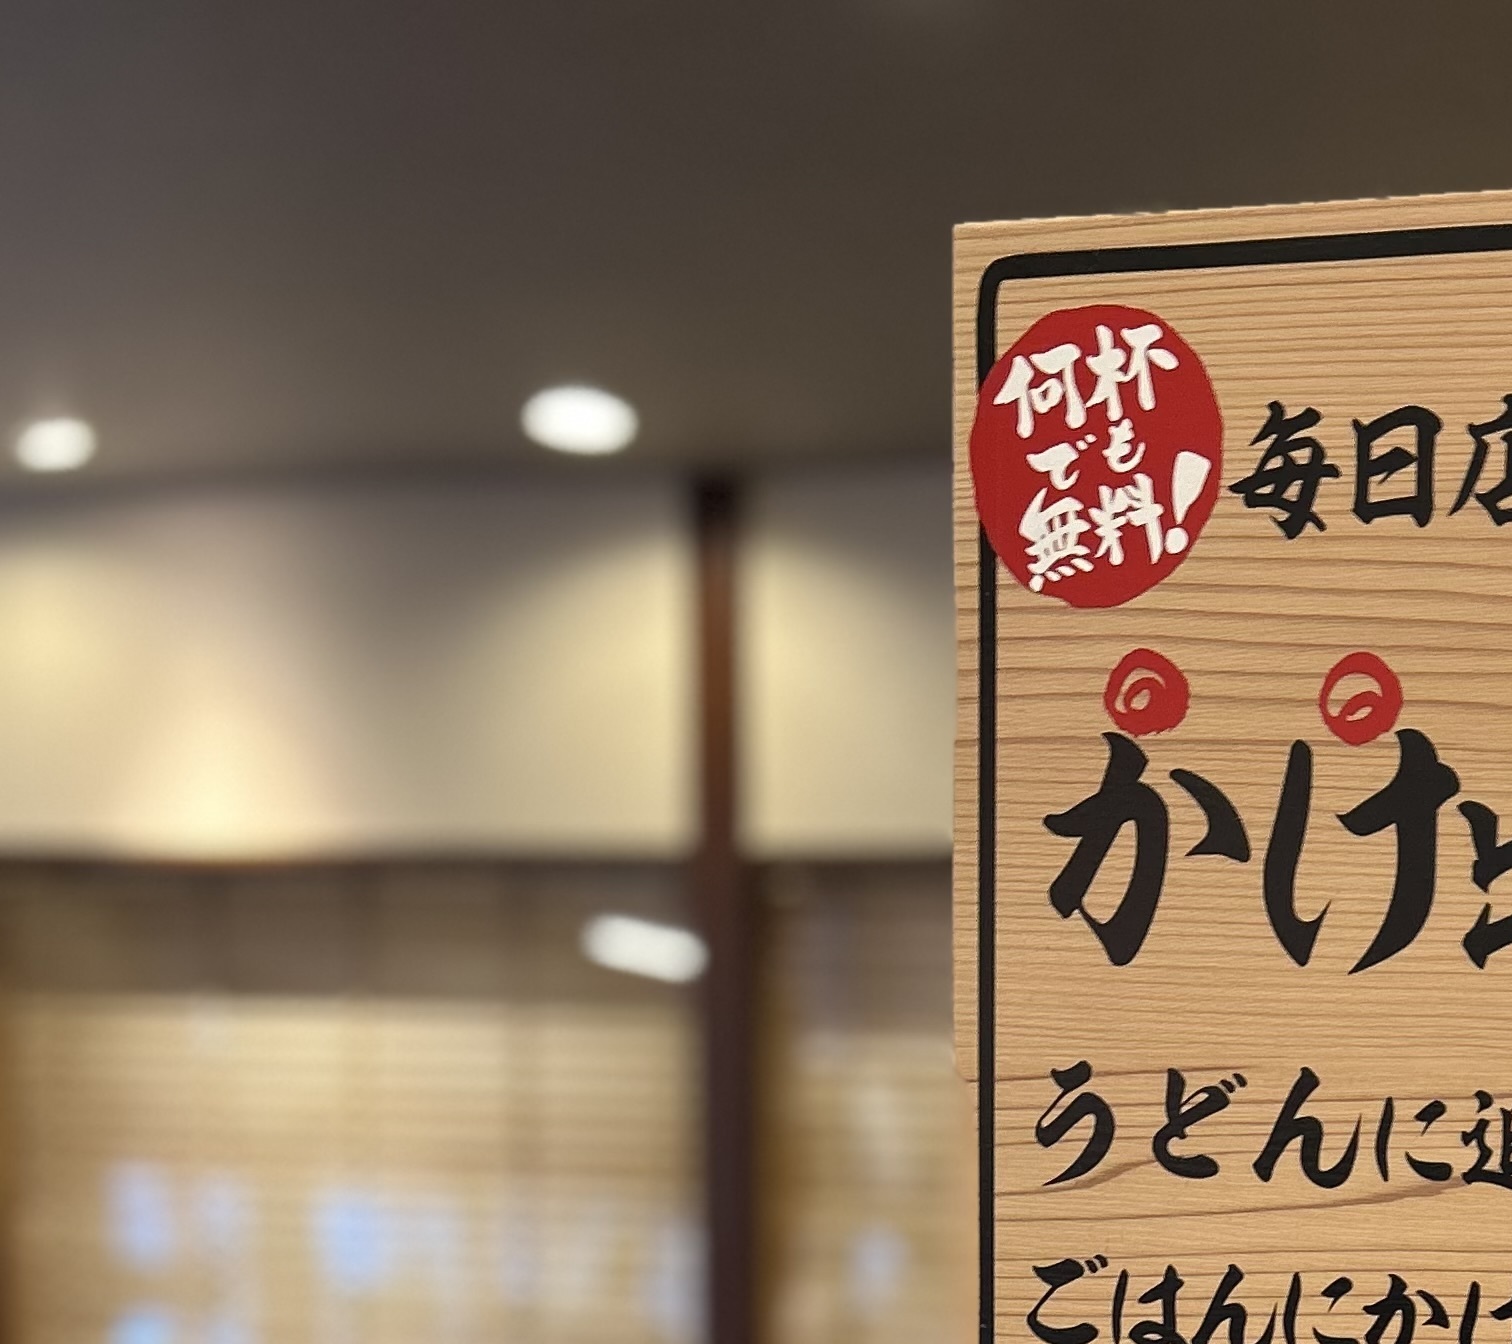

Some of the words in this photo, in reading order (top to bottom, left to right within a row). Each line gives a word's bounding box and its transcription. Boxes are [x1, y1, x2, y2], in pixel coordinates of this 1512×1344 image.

[992, 322, 1180, 439] 何杯
[1025, 417, 1147, 491] でも
[1017, 472, 1213, 594] 無料!
